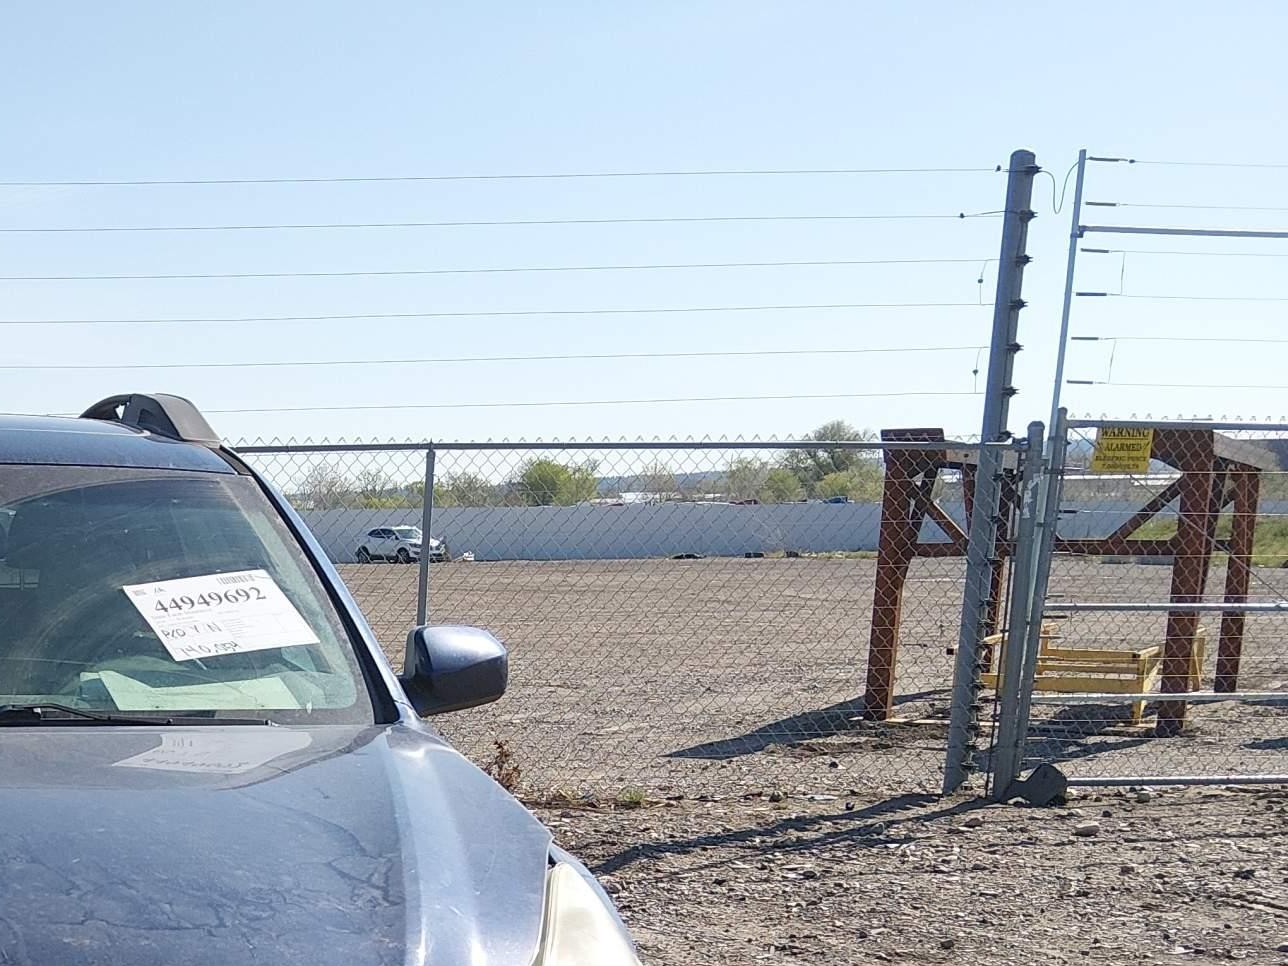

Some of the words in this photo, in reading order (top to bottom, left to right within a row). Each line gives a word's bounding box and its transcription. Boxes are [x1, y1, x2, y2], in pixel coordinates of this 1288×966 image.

[1101, 427, 1150, 437] WARNING
[1104, 442, 1143, 451] ALARMED
[154, 586, 267, 614] 44949692
